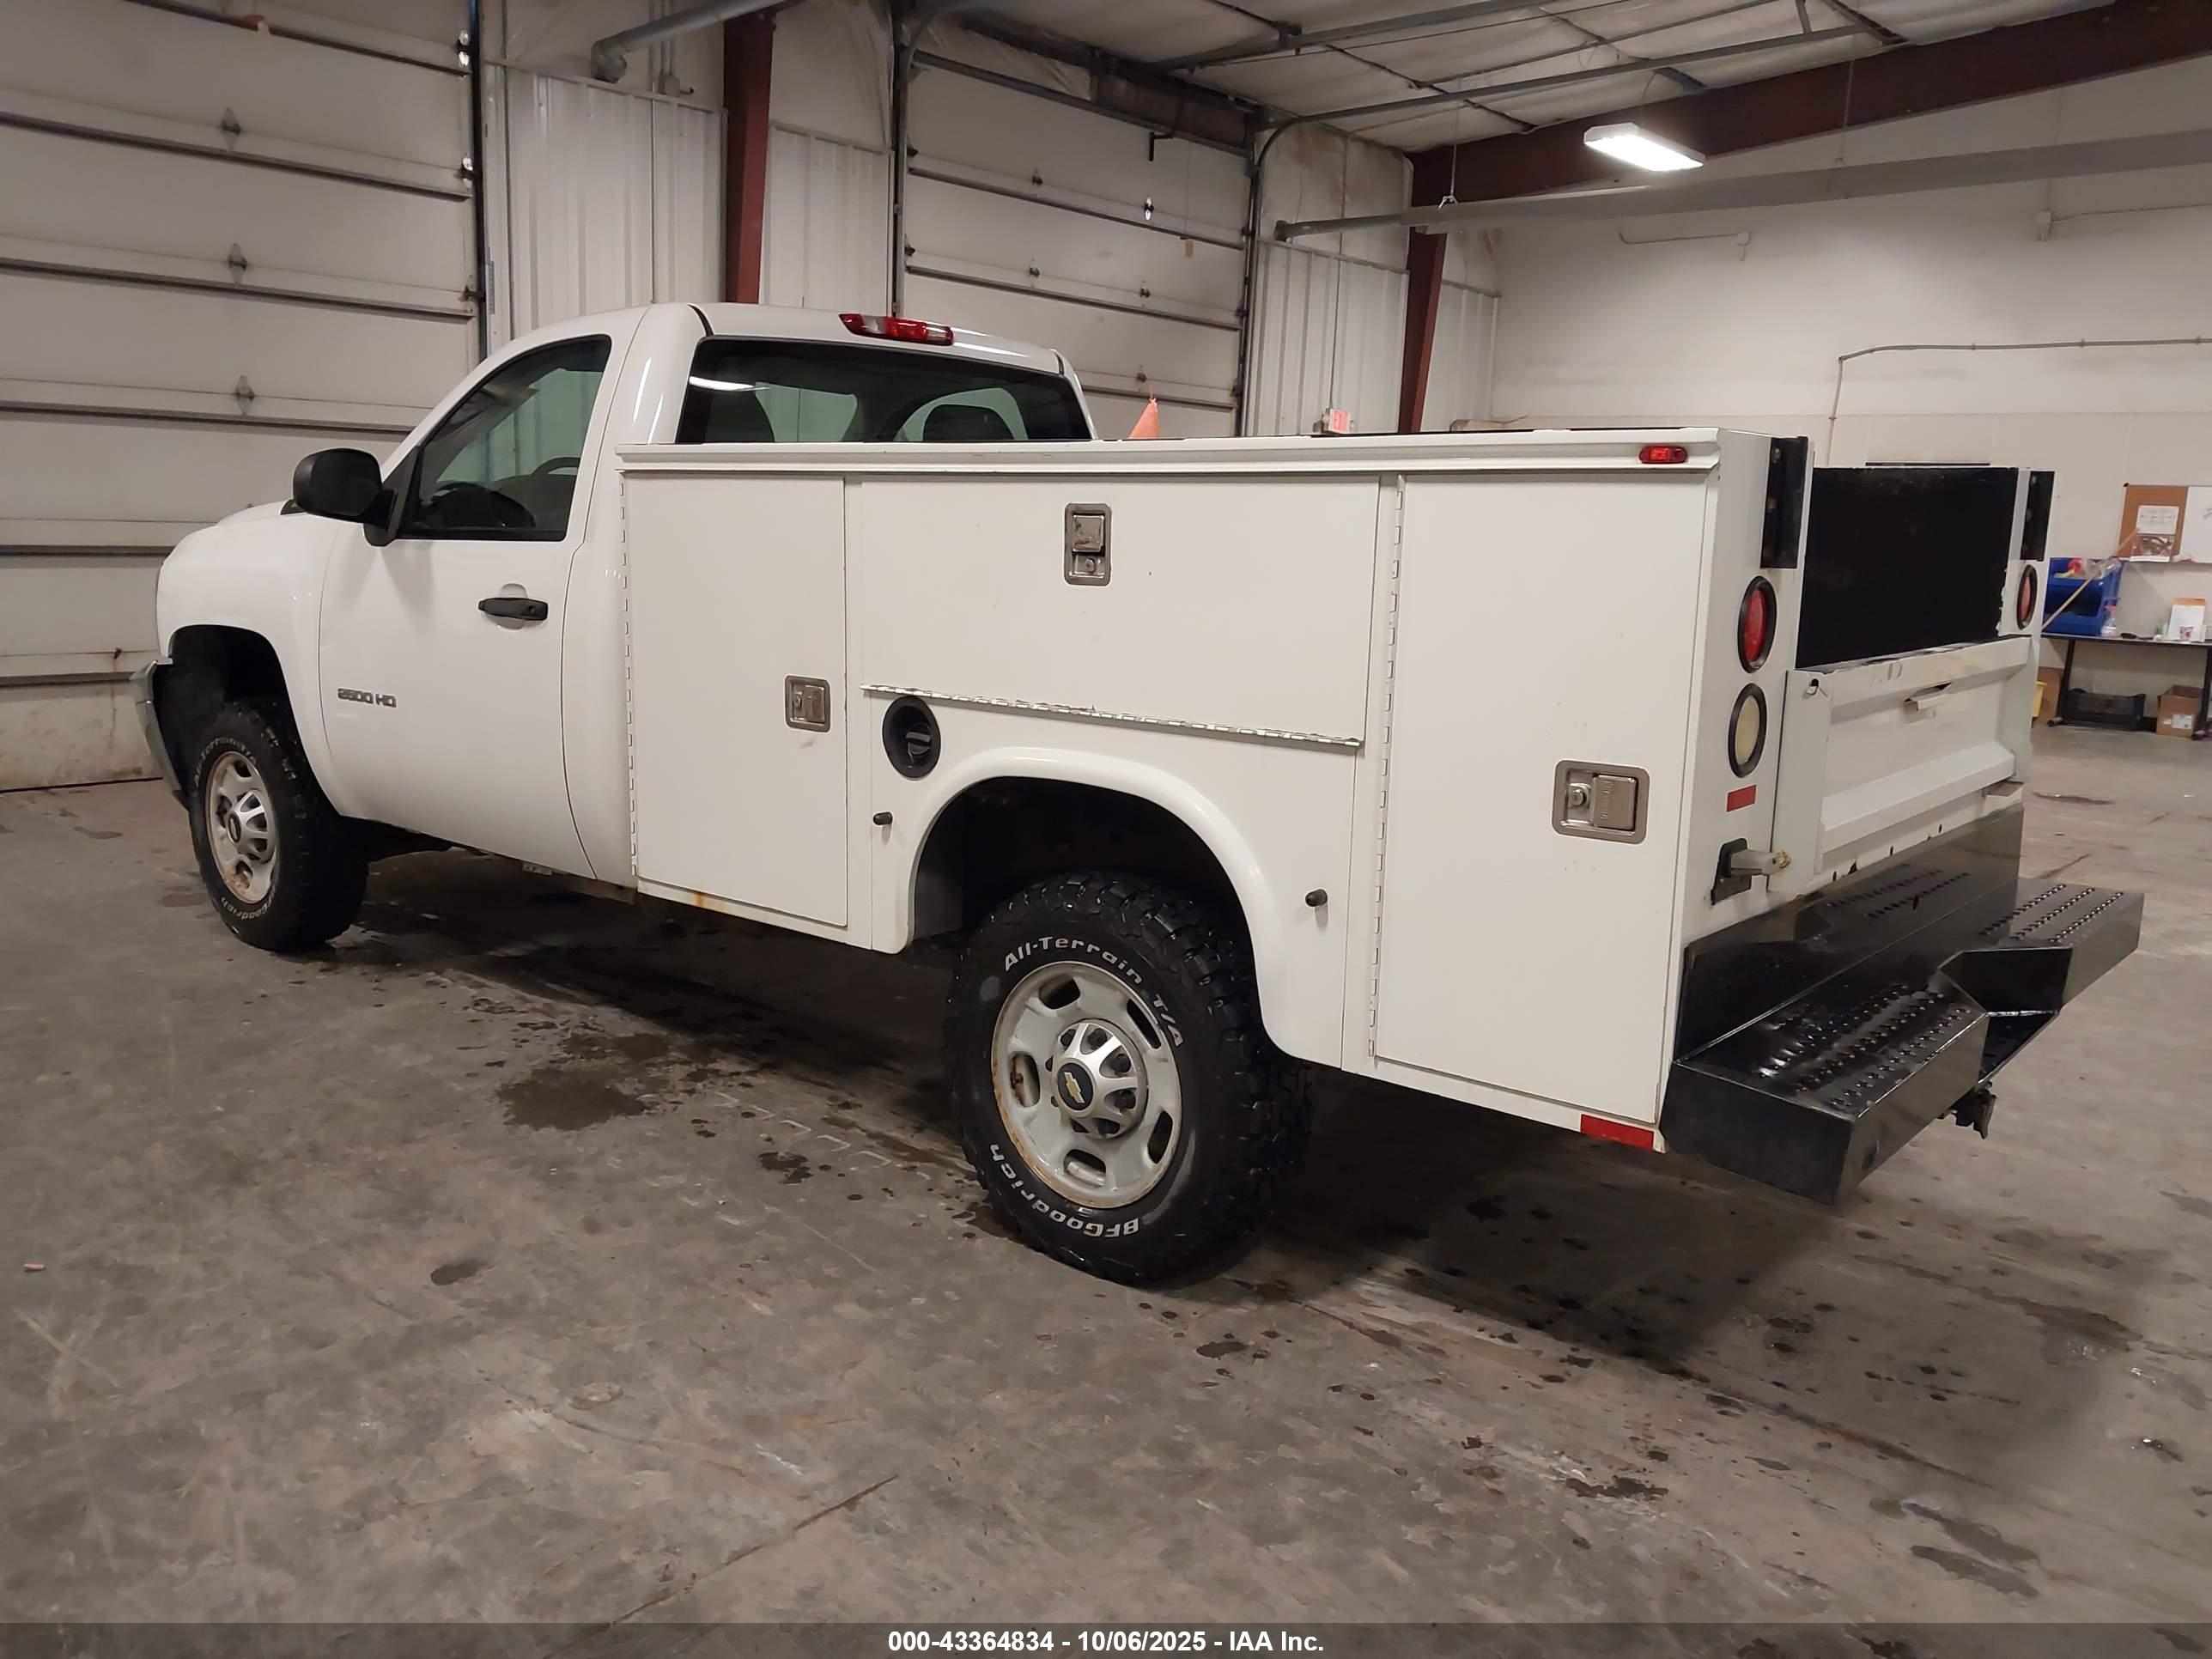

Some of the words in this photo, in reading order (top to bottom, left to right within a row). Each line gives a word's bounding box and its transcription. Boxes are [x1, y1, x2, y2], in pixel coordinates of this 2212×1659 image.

[375, 693, 397, 708] HD
[1005, 936, 1143, 984] All-Terrain
[1152, 994, 1183, 1047] T/A
[990, 1143, 1140, 1238] BFGoodrich
